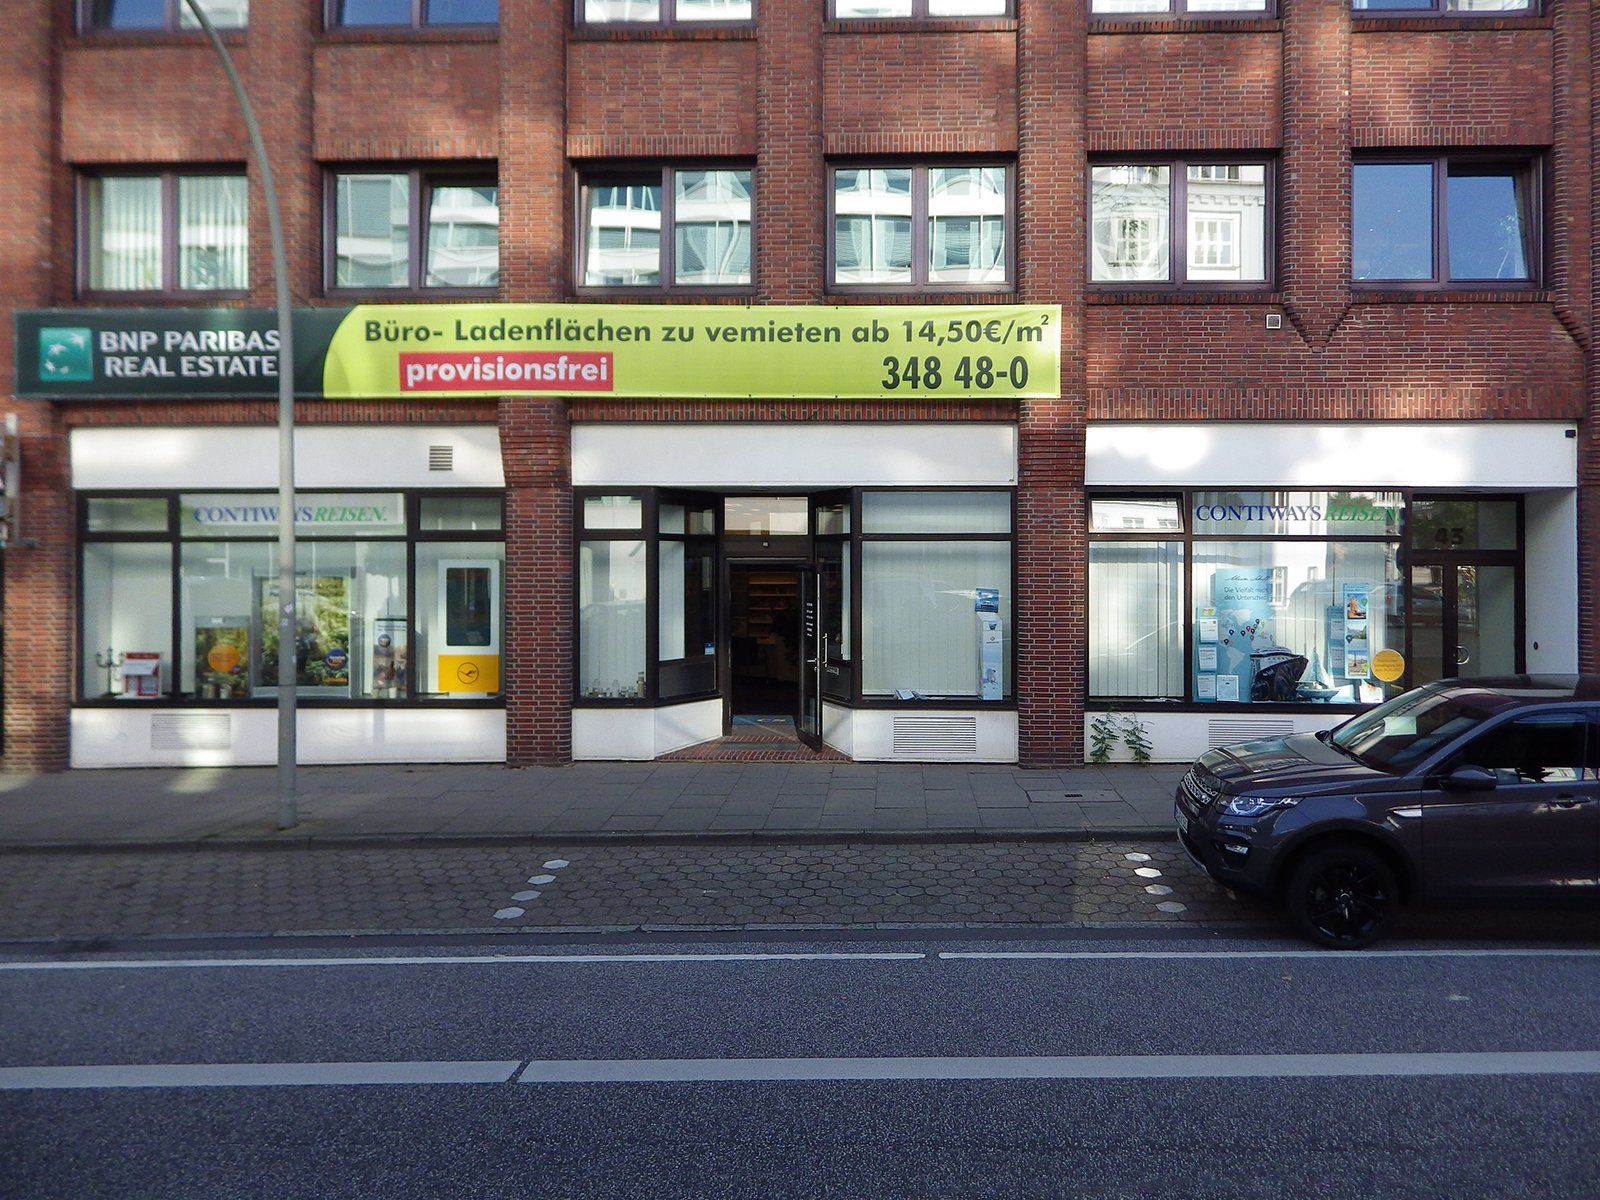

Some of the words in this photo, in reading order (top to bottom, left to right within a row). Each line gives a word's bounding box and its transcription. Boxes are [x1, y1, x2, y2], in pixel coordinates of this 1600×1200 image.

[100, 330, 159, 353] BNP
[164, 329, 281, 353] PARIBAS
[364, 319, 444, 343] Büro-
[455, 317, 651, 343] Ladenflächen
[661, 326, 695, 343] zu
[851, 319, 890, 343] ab
[104, 355, 176, 378] REAL
[180, 355, 278, 377] ESTATE
[406, 355, 608, 387] provisionsfrei
[881, 355, 942, 390] 348
[953, 355, 1029, 389] 48-0
[1434, 527, 1465, 545] 43
